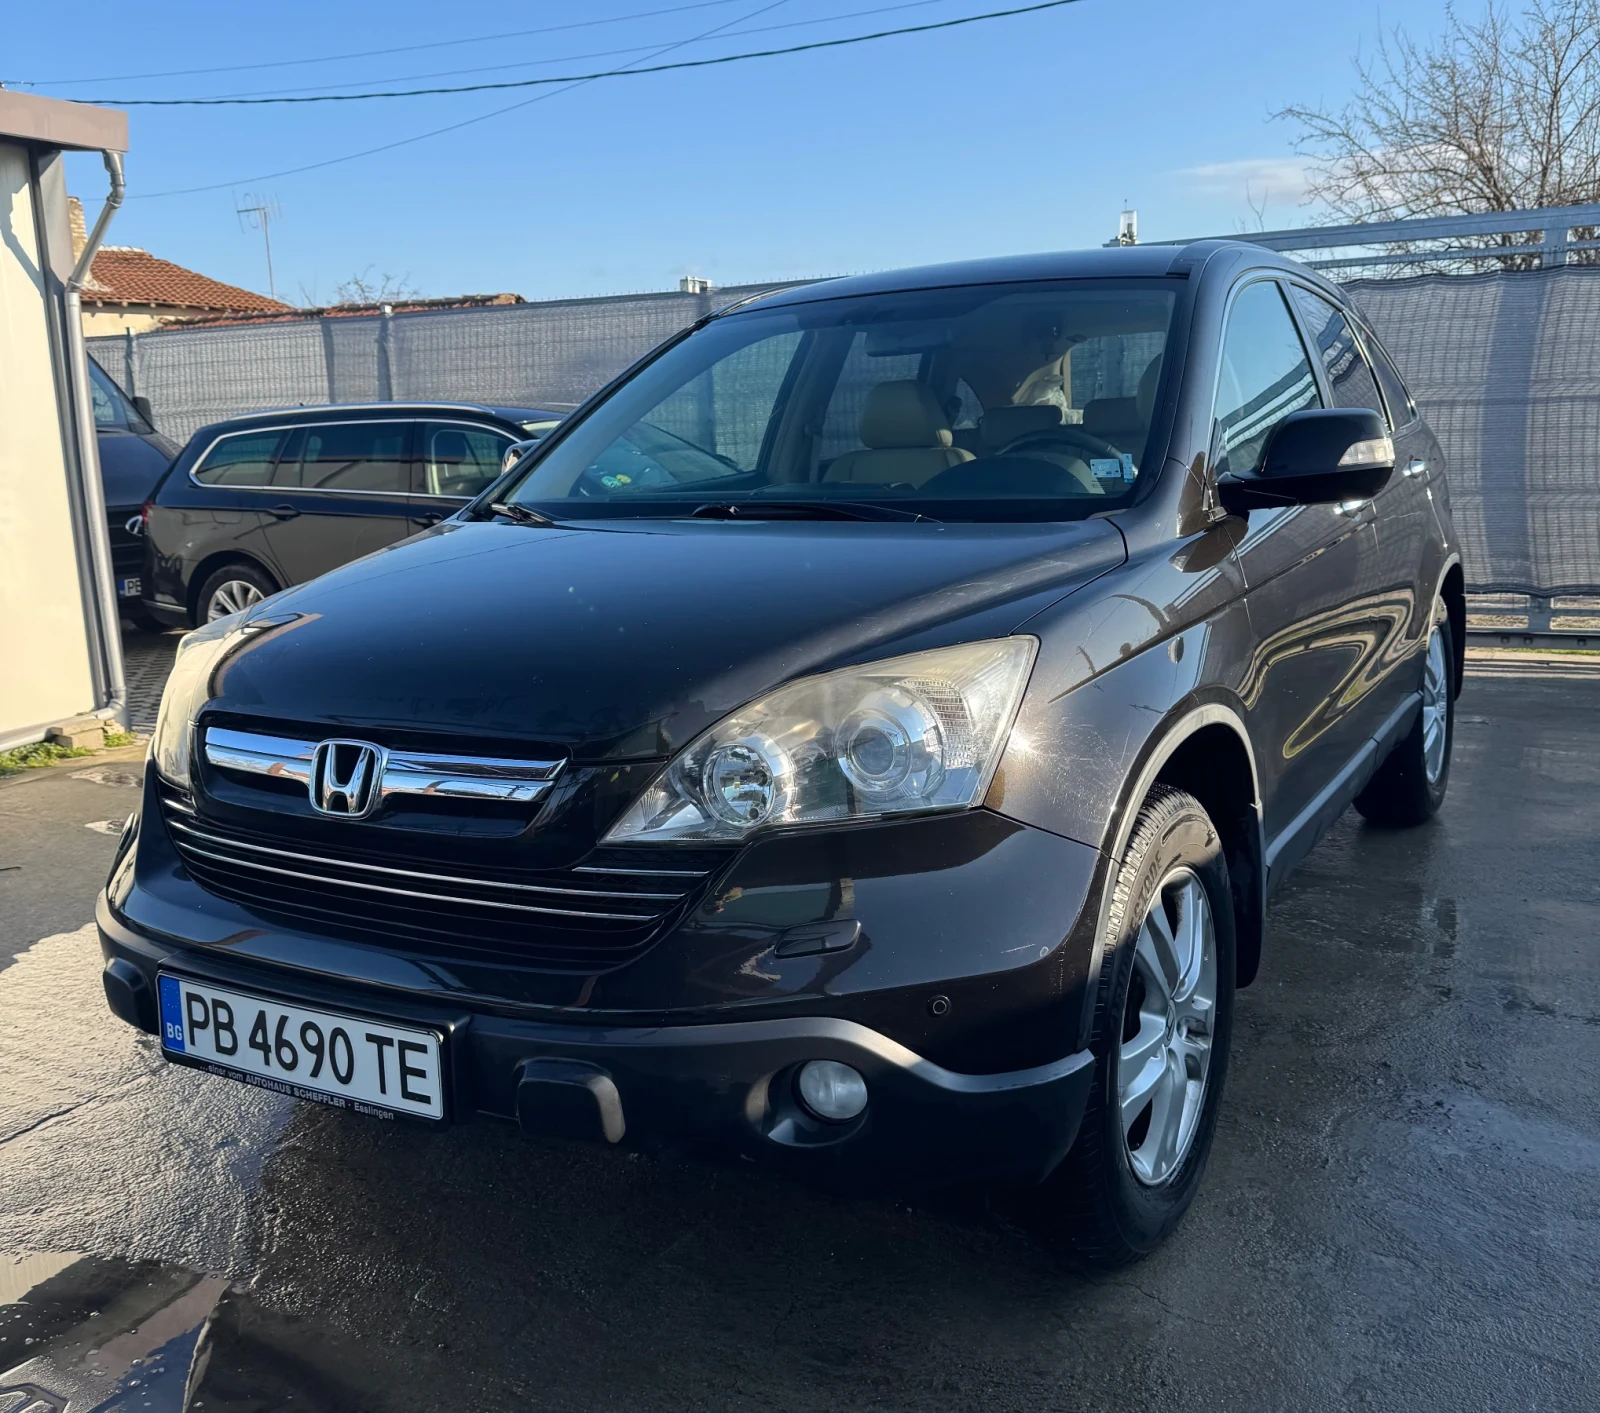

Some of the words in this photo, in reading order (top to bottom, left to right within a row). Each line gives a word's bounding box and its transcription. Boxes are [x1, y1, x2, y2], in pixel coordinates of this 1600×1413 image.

[166, 1022, 182, 1041] BG
[185, 991, 238, 1056] PB
[249, 1009, 354, 1085] 4690
[365, 1032, 432, 1105] TE
[227, 1070, 244, 1081] vom
[246, 1074, 292, 1095] AUTOHAUS
[293, 1087, 346, 1109] SCHEFFLER
[354, 1102, 394, 1120] Esslingen
